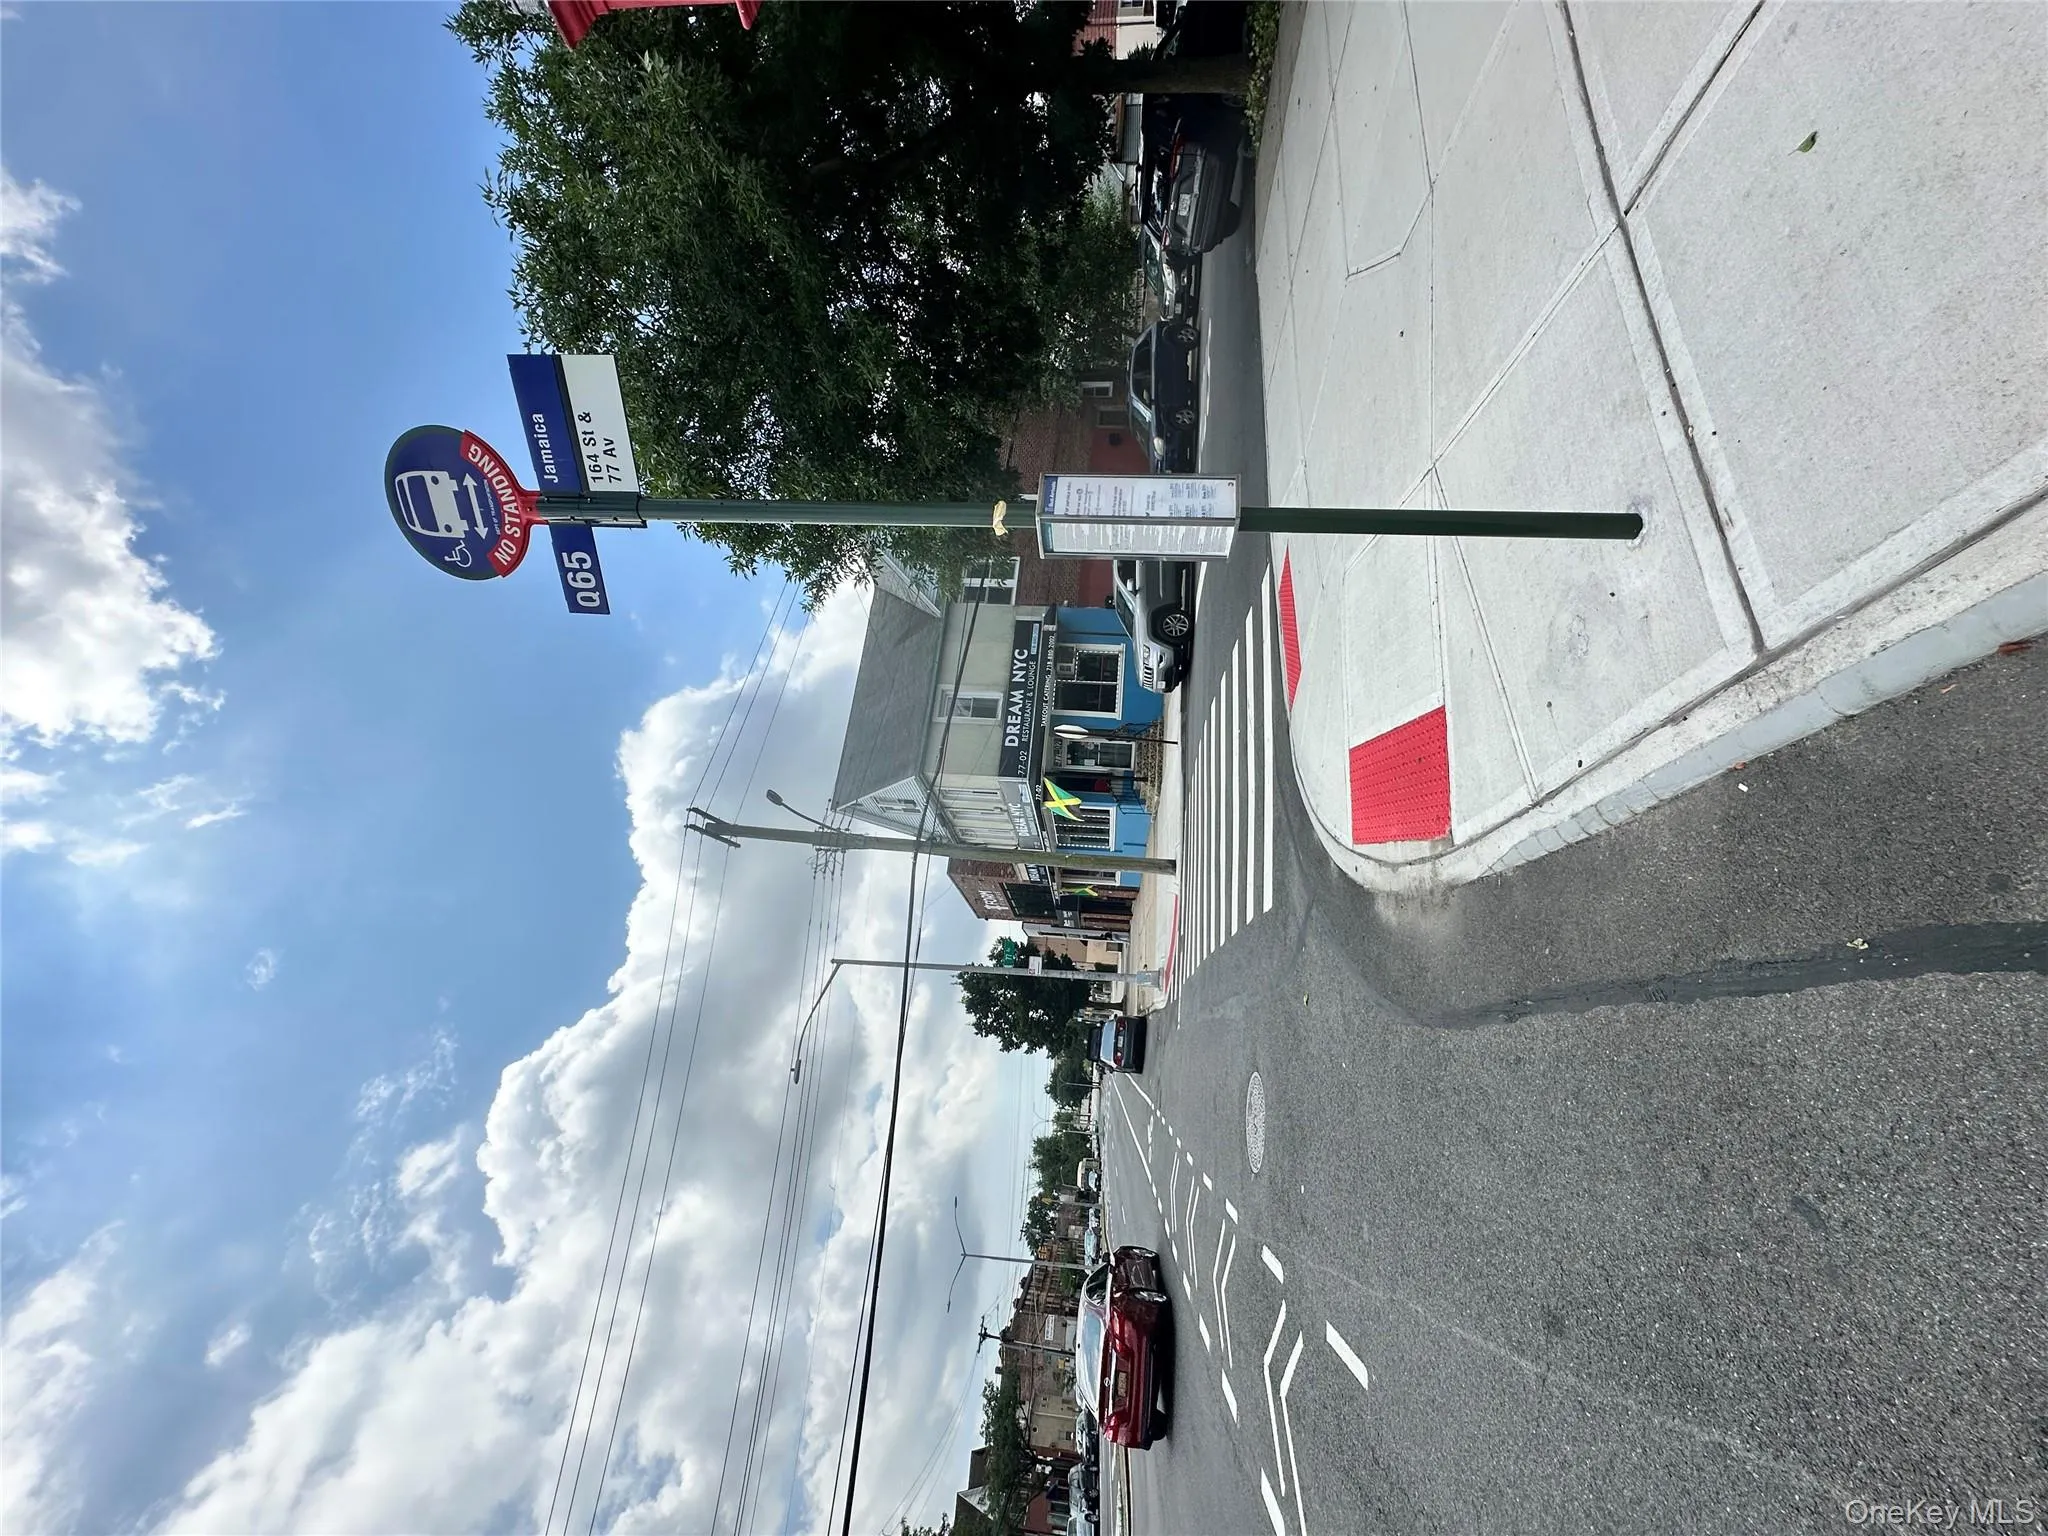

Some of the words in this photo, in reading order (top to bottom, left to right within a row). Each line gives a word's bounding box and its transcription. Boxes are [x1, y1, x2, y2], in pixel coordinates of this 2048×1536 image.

[578, 412, 592, 423] &
[531, 413, 558, 483] Jamaica
[580, 430, 596, 446] St
[603, 438, 617, 458] Av
[586, 454, 604, 483] 164
[606, 464, 622, 483] 77
[467, 443, 520, 538] STANDING
[494, 538, 516, 565] NO
[562, 551, 600, 607] Q65
[1012, 648, 1028, 682] NYC
[1022, 700, 1032, 742] RESTAURANT
[1027, 660, 1036, 688] LOUNGE
[1041, 702, 1049, 727] TAKEOUT
[1004, 690, 1024, 746] DREAM
[1018, 750, 1028, 775] 77-02
